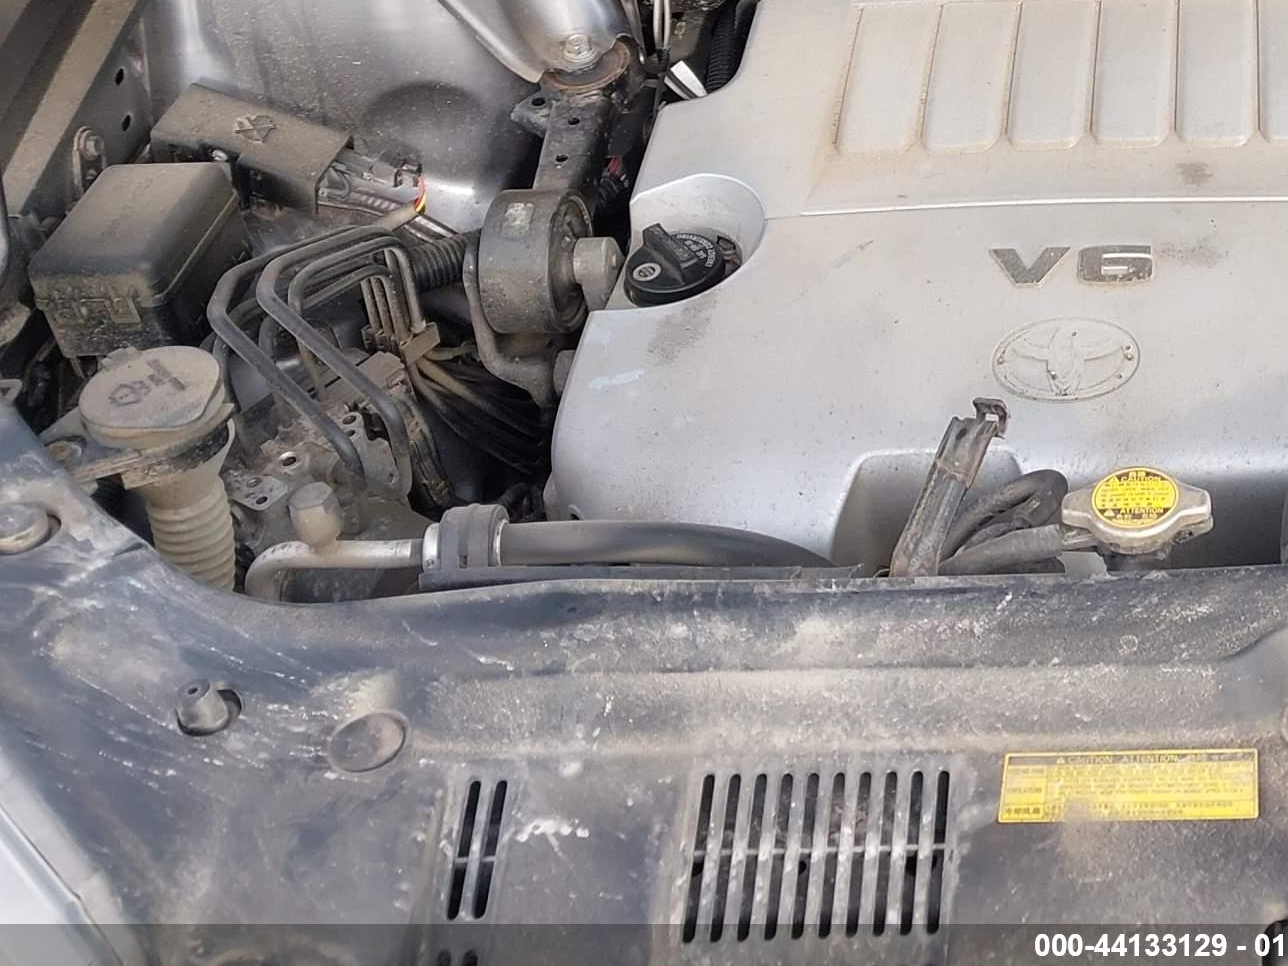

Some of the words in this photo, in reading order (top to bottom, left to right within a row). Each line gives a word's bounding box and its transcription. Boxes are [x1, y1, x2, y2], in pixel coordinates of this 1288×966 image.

[989, 244, 1154, 288] V6
[1068, 755, 1114, 765] CAUTION
[1121, 753, 1179, 764] ATTENTION
